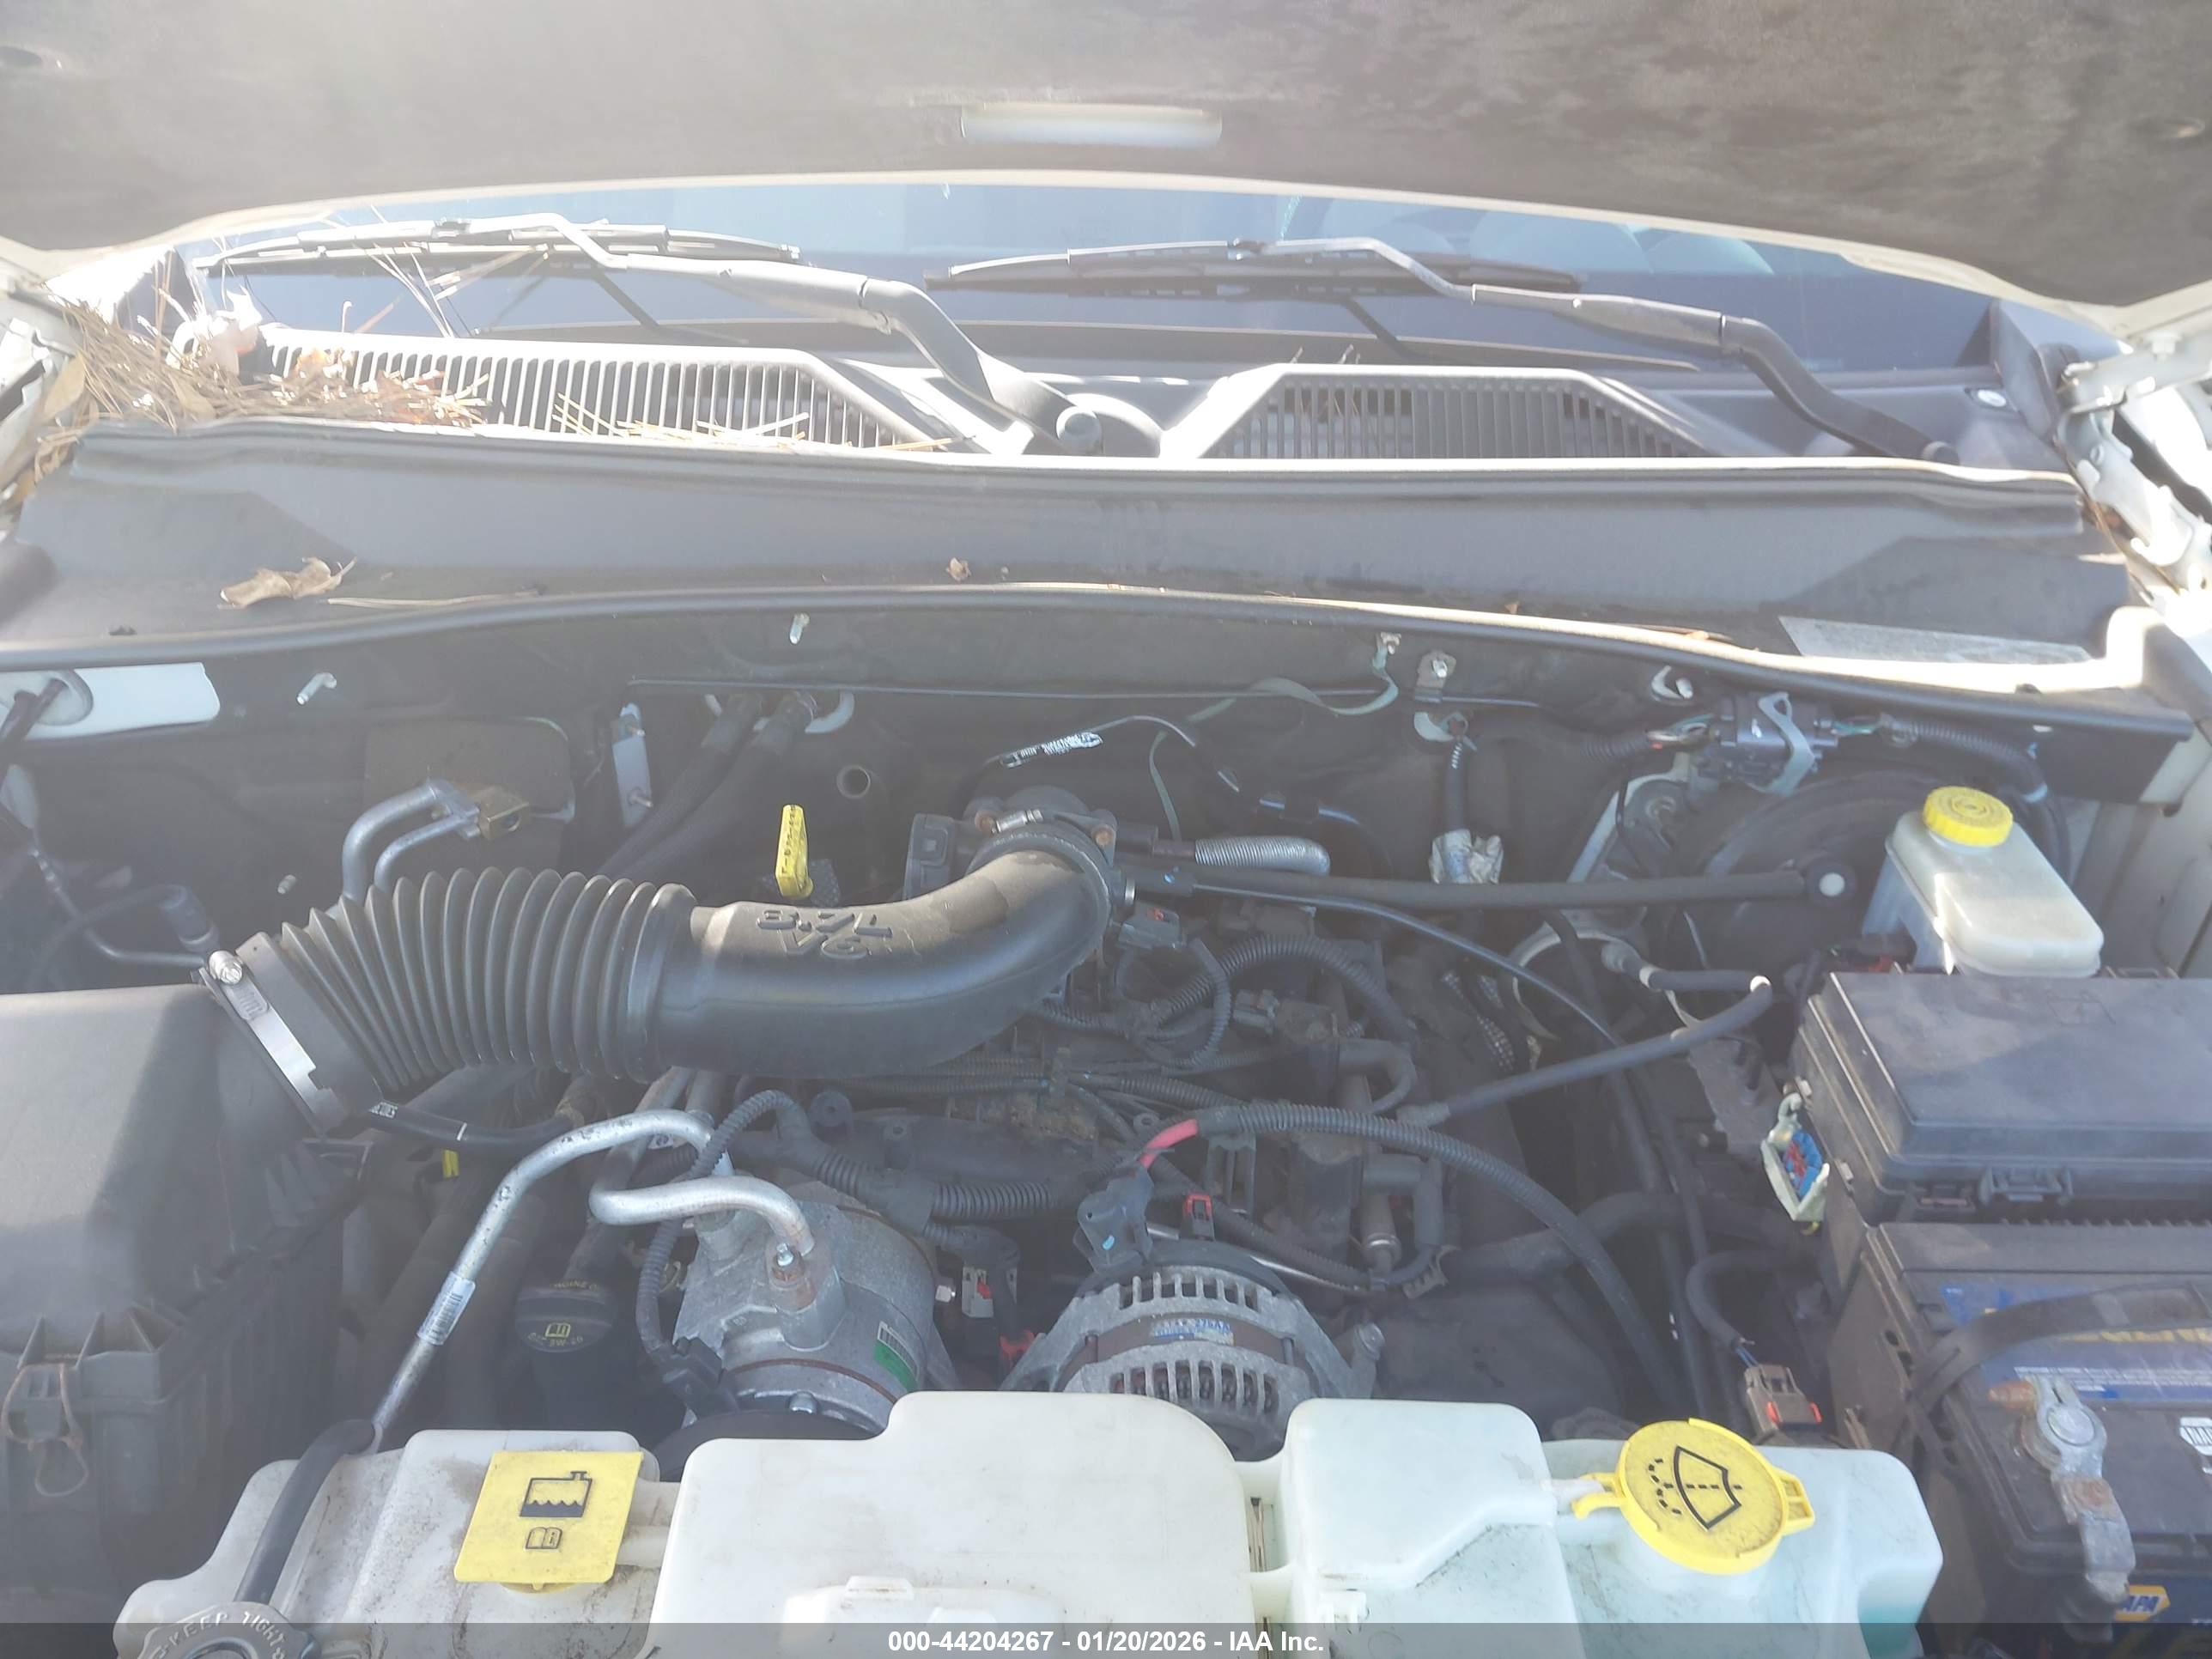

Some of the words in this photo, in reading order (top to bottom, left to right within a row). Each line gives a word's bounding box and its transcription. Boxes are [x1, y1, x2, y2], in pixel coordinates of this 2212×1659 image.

[757, 908, 893, 938] 3.7L
[777, 929, 867, 960] V6
[2119, 1595, 2160, 1613] APA
[168, 1611, 228, 1647] KEEP
[242, 1611, 287, 1648] TIGHT
